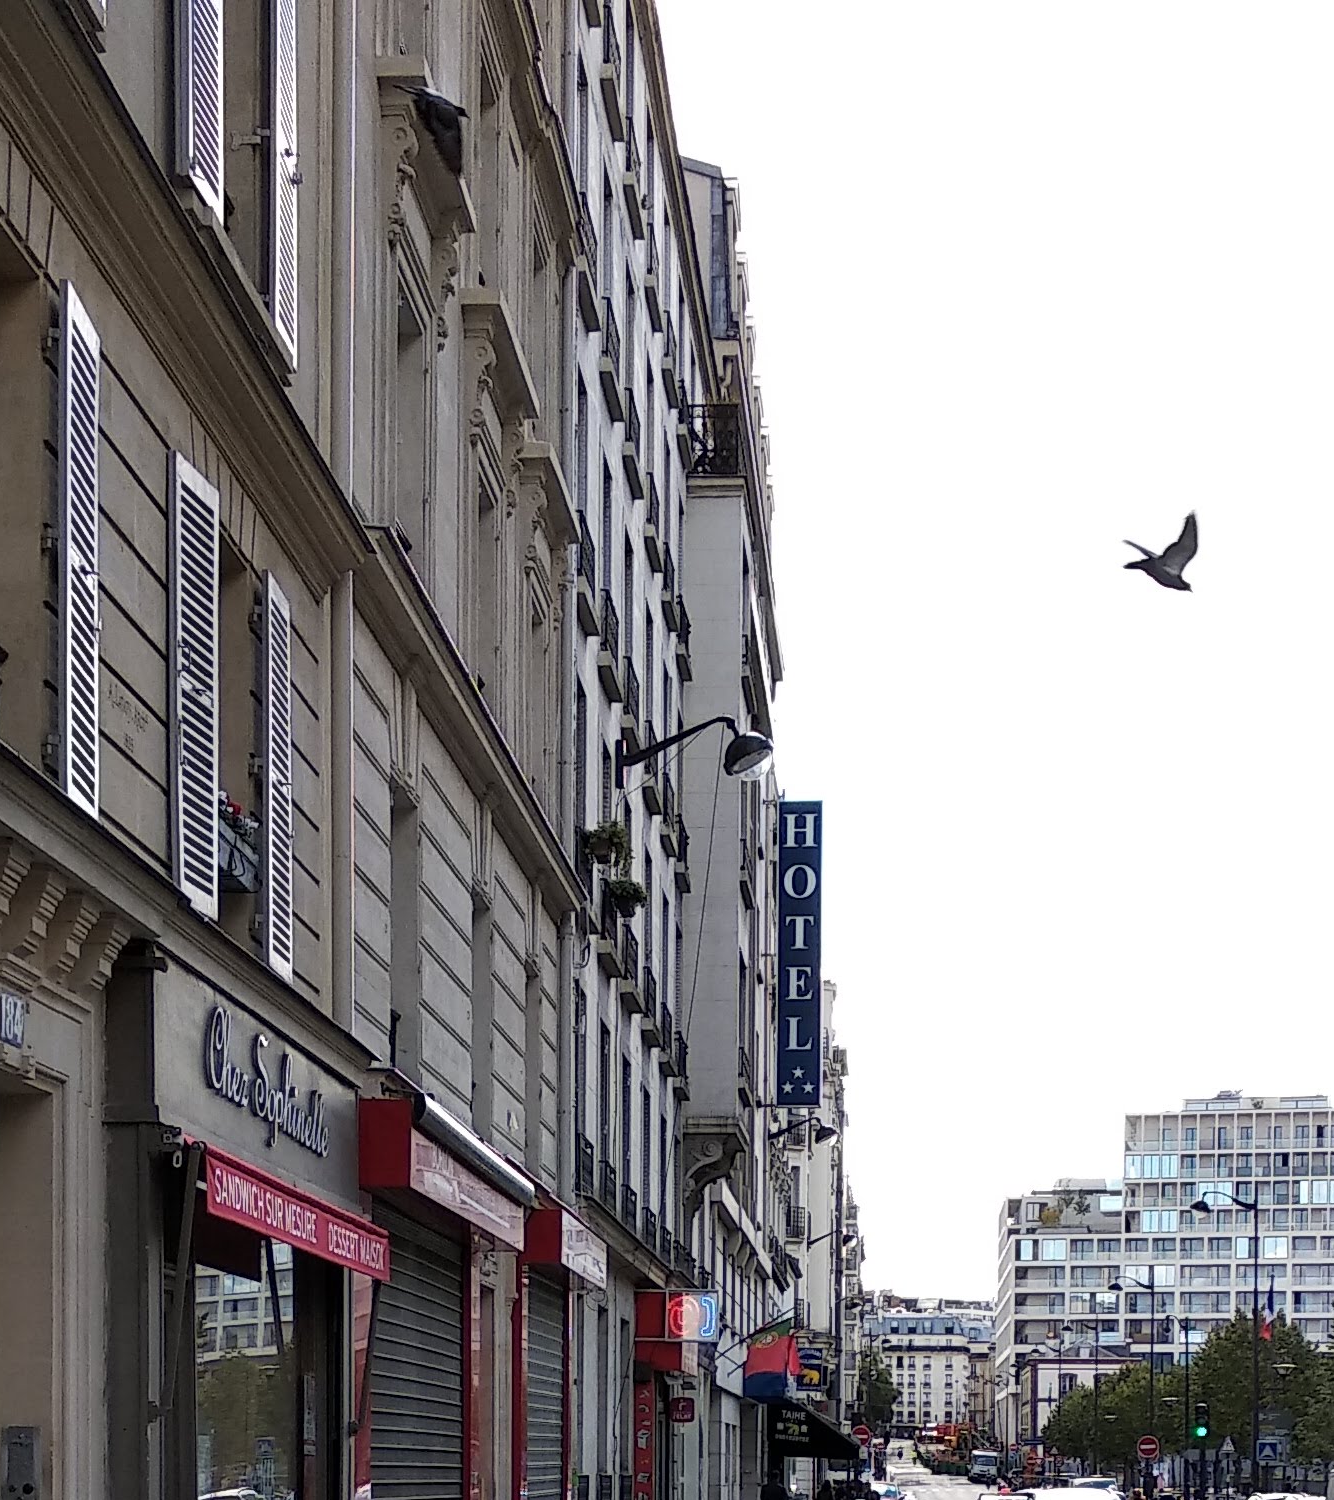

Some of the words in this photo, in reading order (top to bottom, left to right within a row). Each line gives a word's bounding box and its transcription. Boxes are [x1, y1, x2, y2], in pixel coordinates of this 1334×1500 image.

[782, 813, 818, 1050] HOTEL
[0, 992, 25, 1044] 184
[208, 1006, 249, 1107] Chez
[253, 1034, 329, 1158] Sophinelle
[214, 1168, 265, 1220] SANDWICH
[265, 1191, 283, 1230] SUR
[285, 1201, 318, 1244] MESURE
[328, 1222, 359, 1260] DESSERT
[359, 1236, 384, 1271] MAISON
